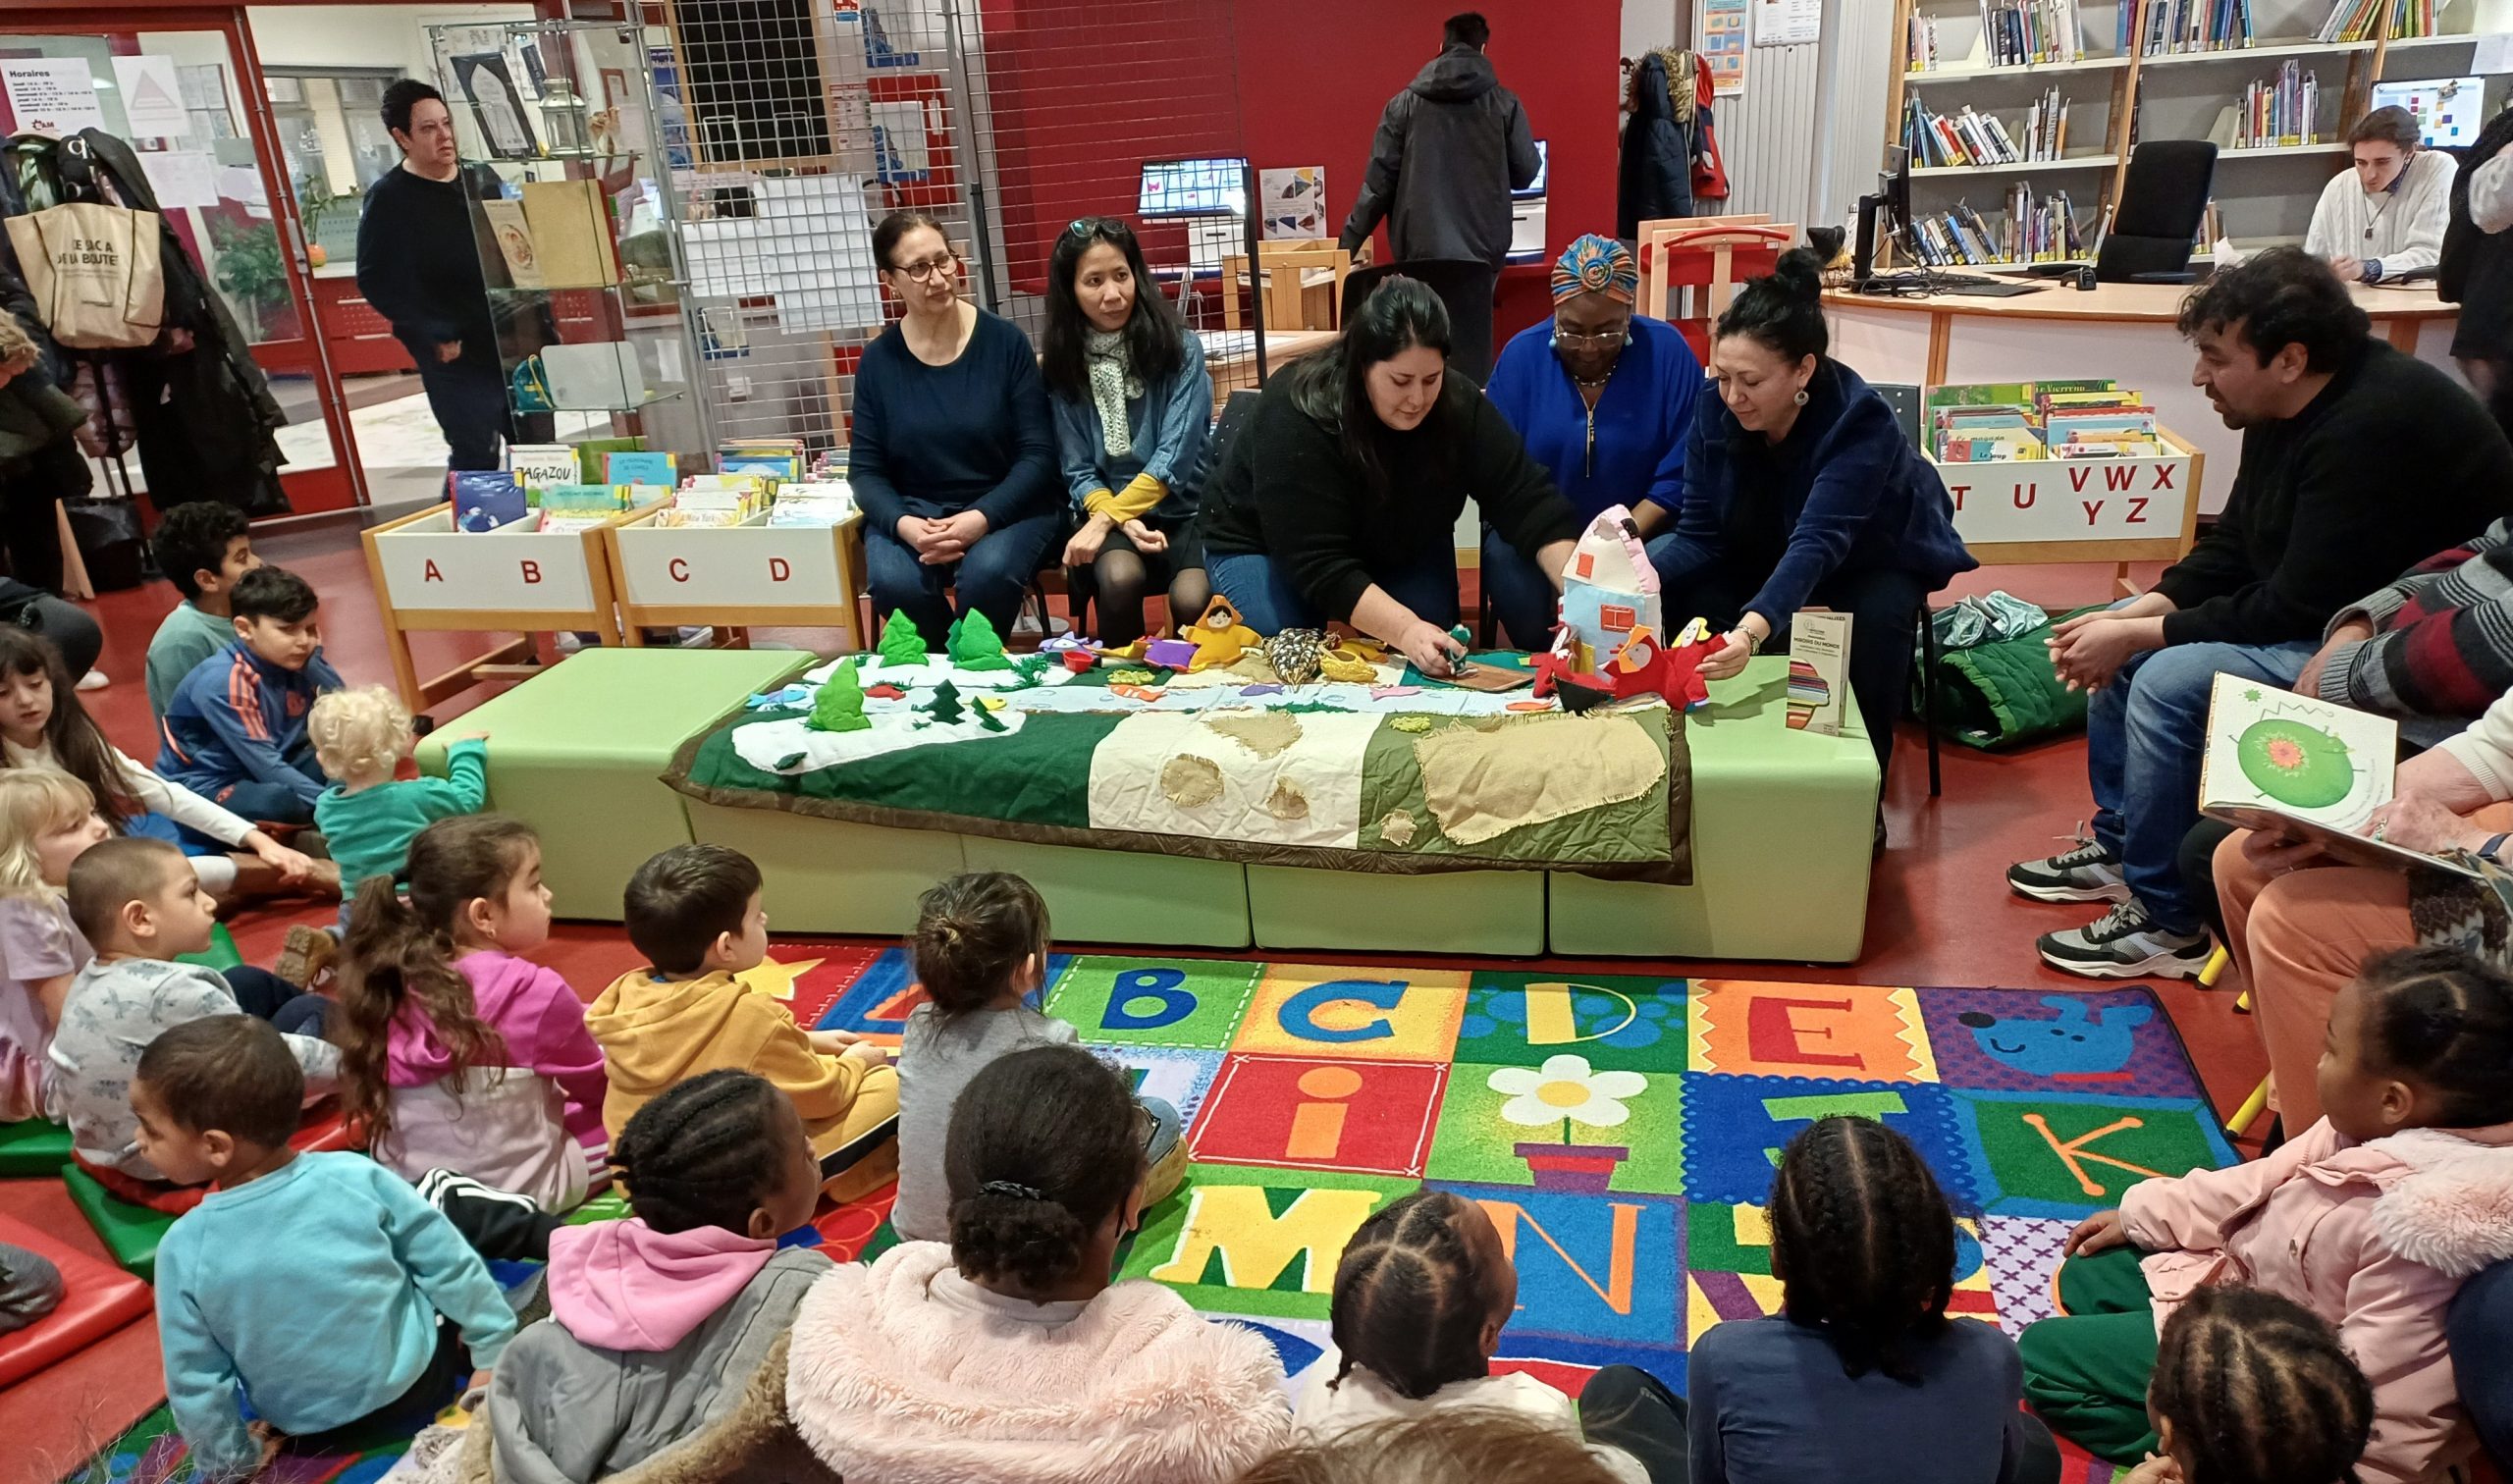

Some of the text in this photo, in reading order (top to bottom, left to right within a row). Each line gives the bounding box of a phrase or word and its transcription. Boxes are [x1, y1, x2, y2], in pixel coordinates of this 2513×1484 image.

[2068, 463, 2177, 493] V W X
[1950, 483, 2037, 511] T U
[2082, 497, 2149, 526] Y Z
[423, 557, 542, 584] A B
[668, 556, 790, 583] C D
[1098, 968, 1866, 1071] B C D E
[2022, 1113, 2171, 1197] K
[1149, 1185, 1647, 1315] M N
